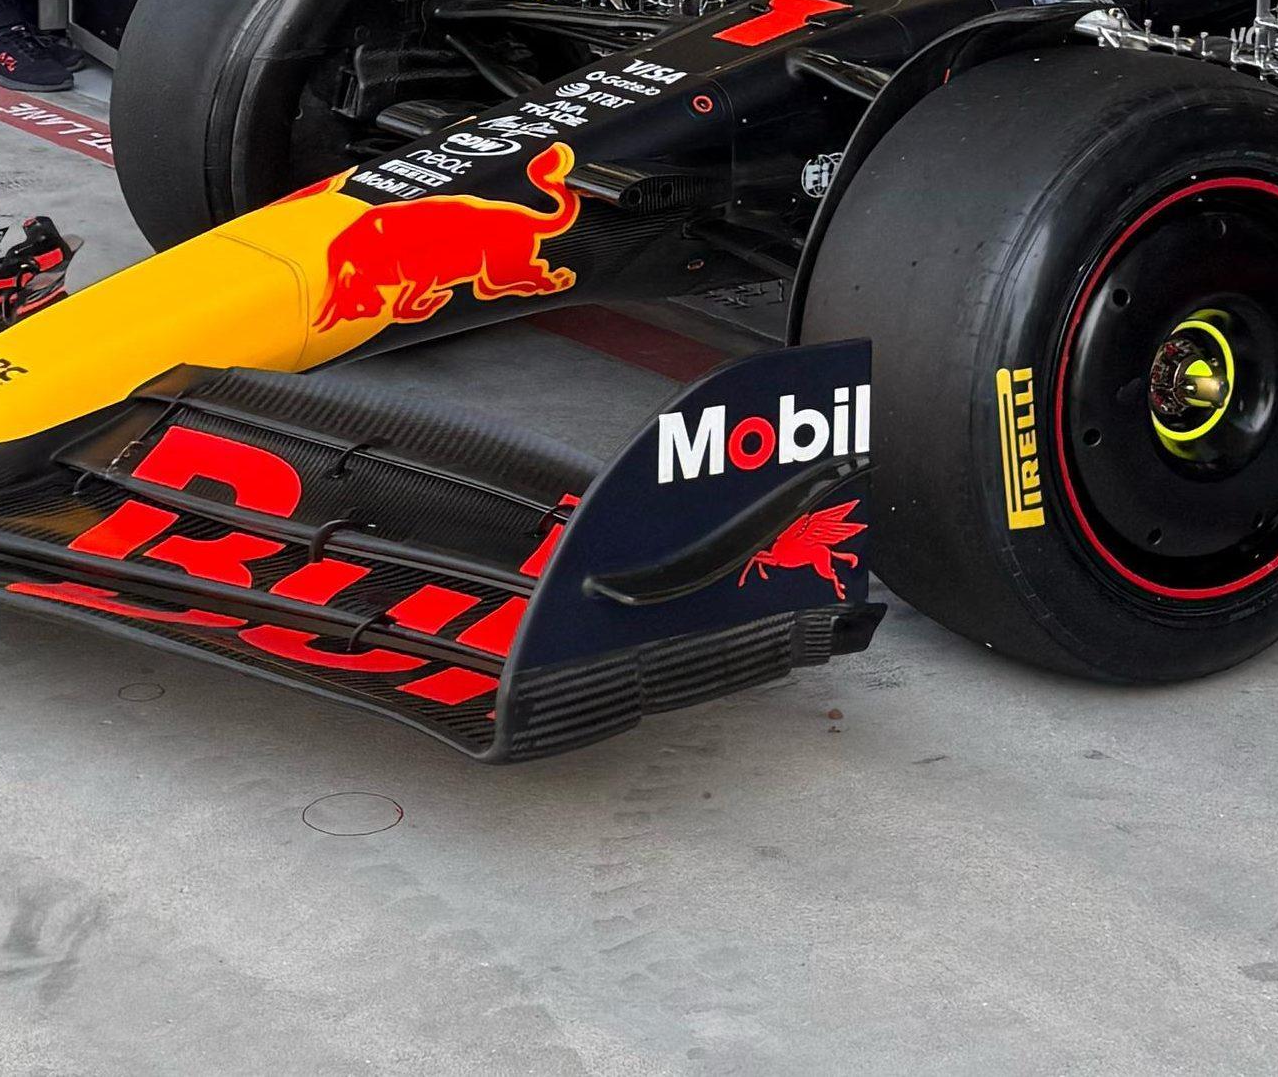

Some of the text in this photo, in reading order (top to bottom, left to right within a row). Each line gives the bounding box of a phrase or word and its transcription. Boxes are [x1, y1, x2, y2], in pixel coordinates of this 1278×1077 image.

[621, 58, 688, 85] VISA
[601, 75, 661, 96] Gate.io
[545, 100, 587, 116] AVA
[578, 90, 636, 110] AT&T
[519, 102, 589, 127] TRADE
[446, 132, 505, 153] CDW
[350, 171, 402, 194] Mobil
[378, 159, 453, 188] PIRELLI
[657, 383, 872, 485] Mobil
[995, 367, 1046, 530] PIRELLI
